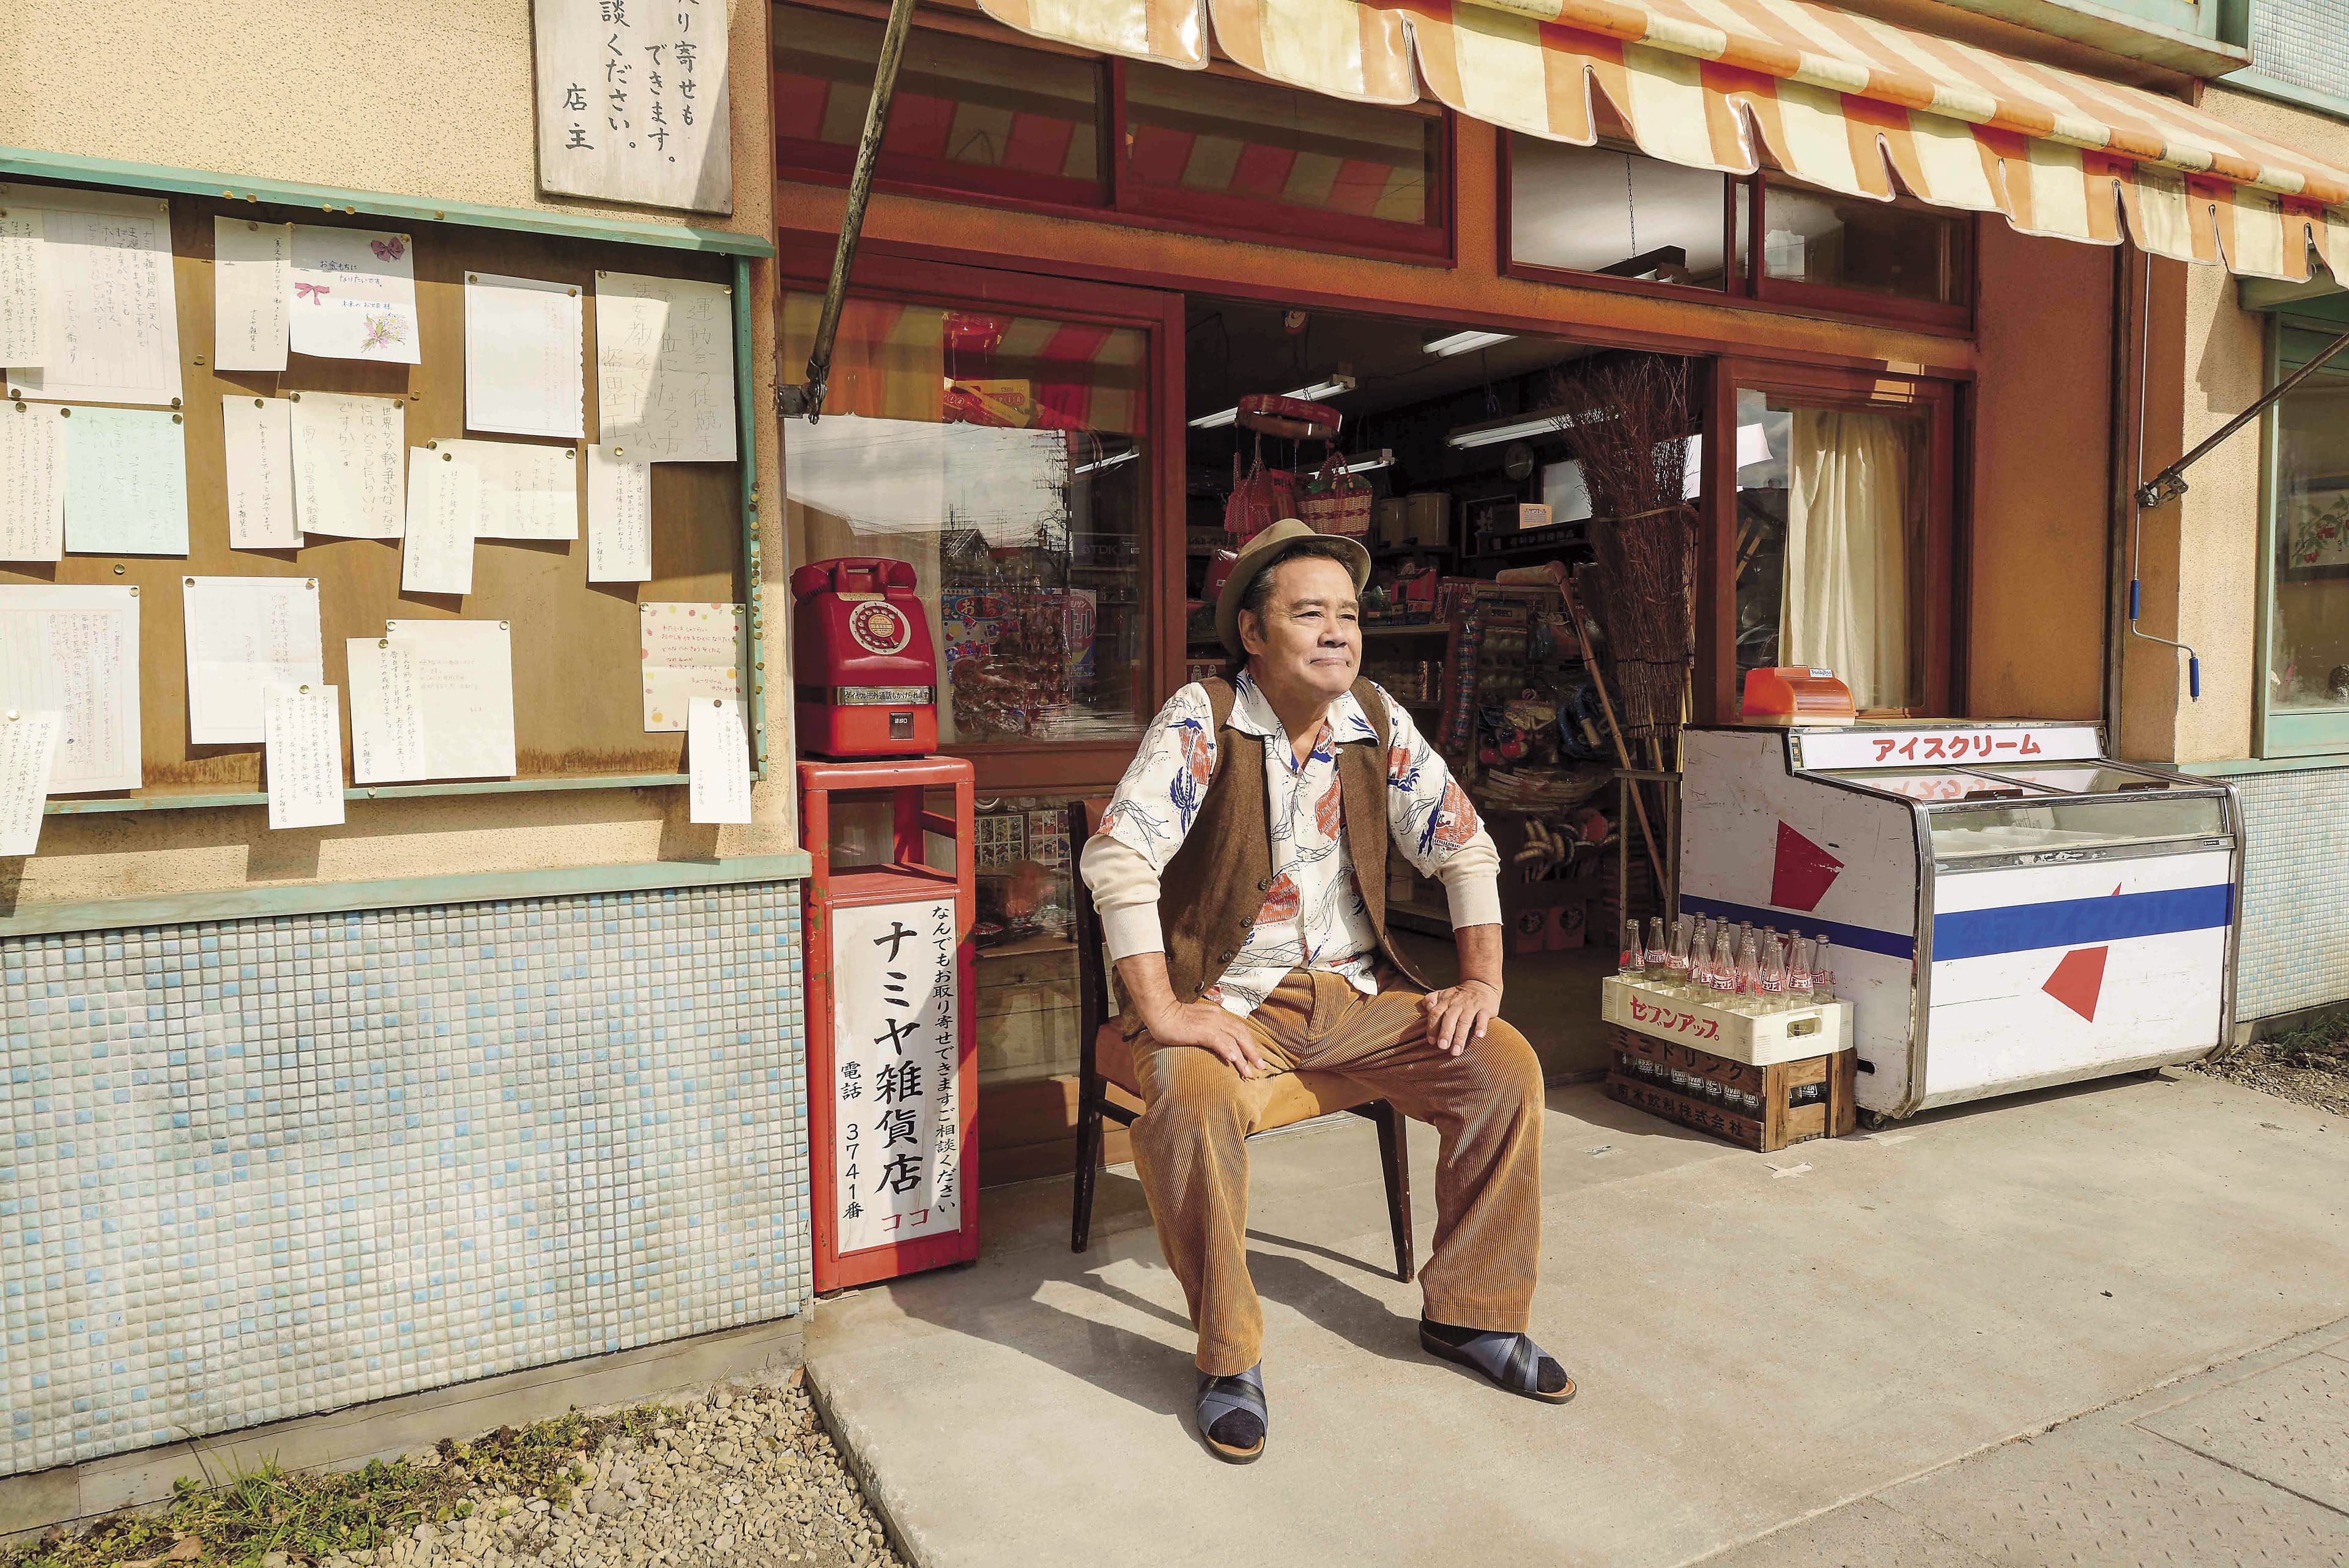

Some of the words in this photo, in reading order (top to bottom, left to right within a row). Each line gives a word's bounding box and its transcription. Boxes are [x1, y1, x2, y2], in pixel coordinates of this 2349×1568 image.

[675, 0, 699, 125] り寄せも
[563, 83, 594, 150] 店主
[645, 44, 675, 163] できます。
[845, 691, 929, 700] ダイヤル市外通話もかけられます
[1872, 734, 2041, 762] アイスクリーム
[1630, 994, 1720, 1042] セブンアップ
[841, 1061, 863, 1100] 電話
[874, 921, 924, 1195] ナミヤ雑貨店
[932, 905, 957, 1214] なんでもお取り寄せできますご相談ください
[1619, 1030, 1743, 1081] ミニドリンク
[842, 1123, 864, 1220] 3741番
[881, 1208, 931, 1233] ココ
